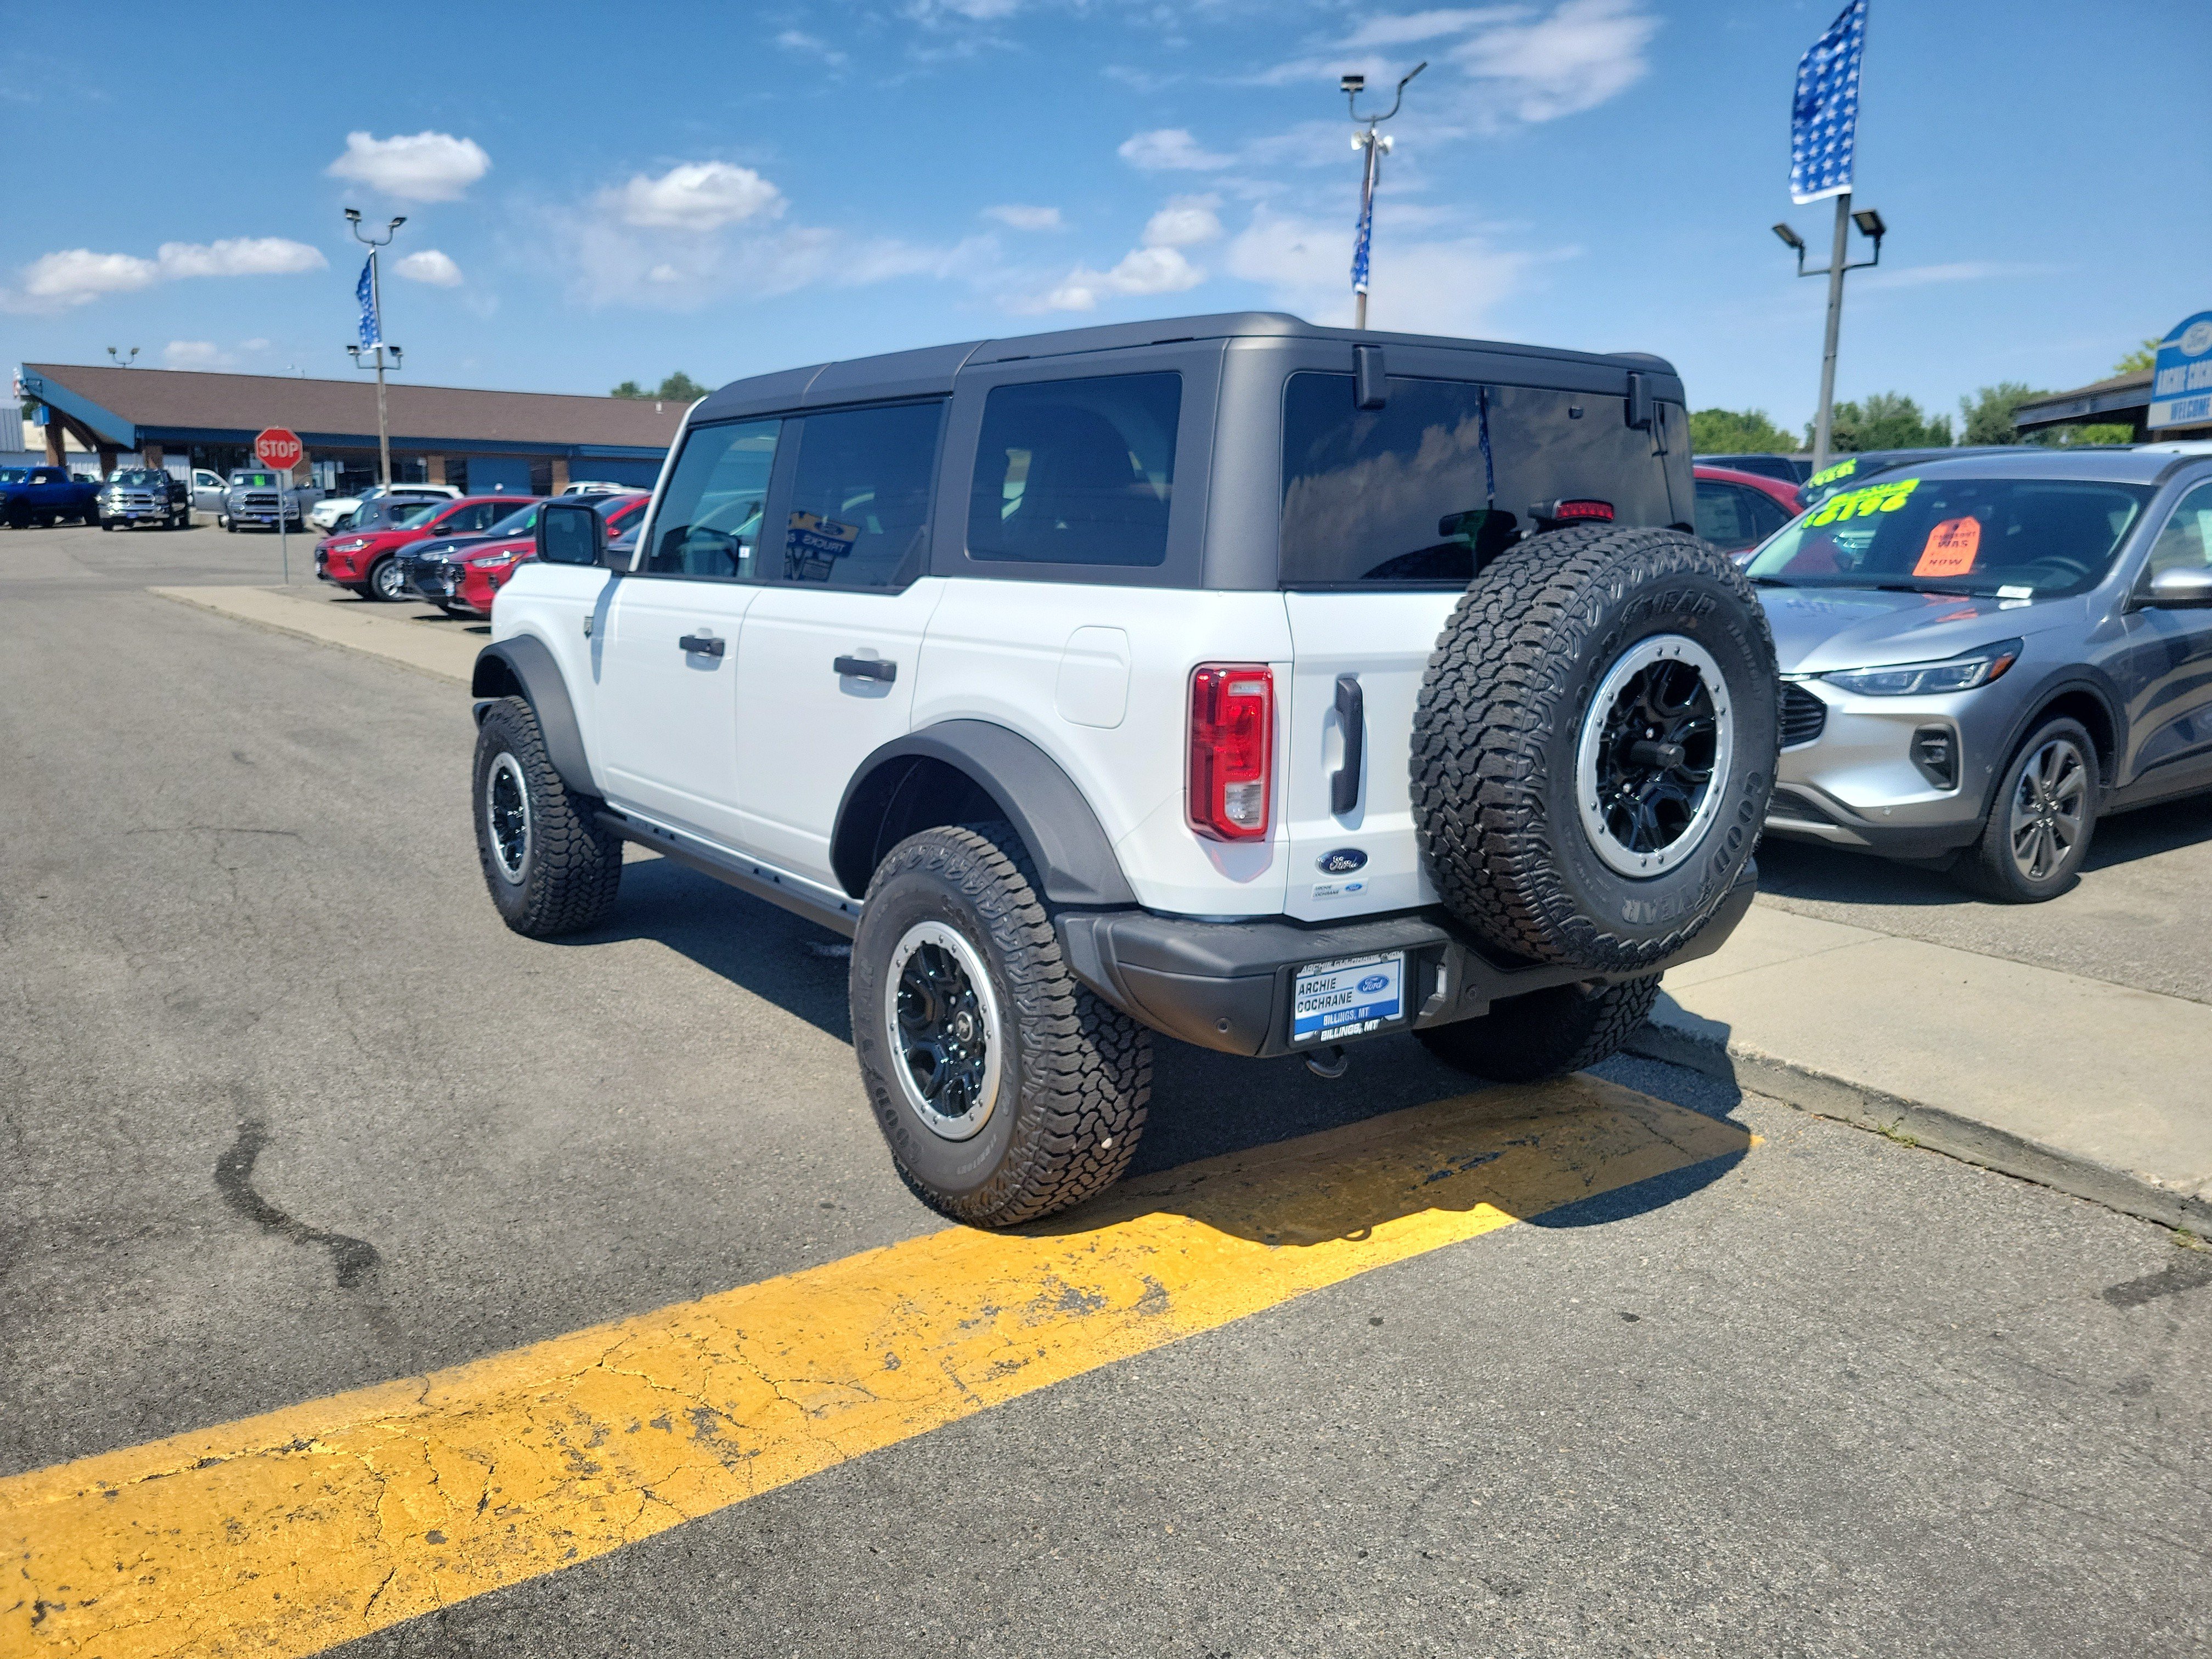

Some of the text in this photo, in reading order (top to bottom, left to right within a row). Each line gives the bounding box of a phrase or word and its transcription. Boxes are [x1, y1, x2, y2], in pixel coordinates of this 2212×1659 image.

[259, 439, 298, 458] STOP
[1938, 540, 1968, 548] WAS
[1298, 978, 1382, 996] ARCHIE Ford
[1297, 992, 1352, 1013] COCHRANE
[1323, 1007, 1370, 1026] BILLINGS, MT
[1321, 1019, 1379, 1041] BILLINGS, MT
